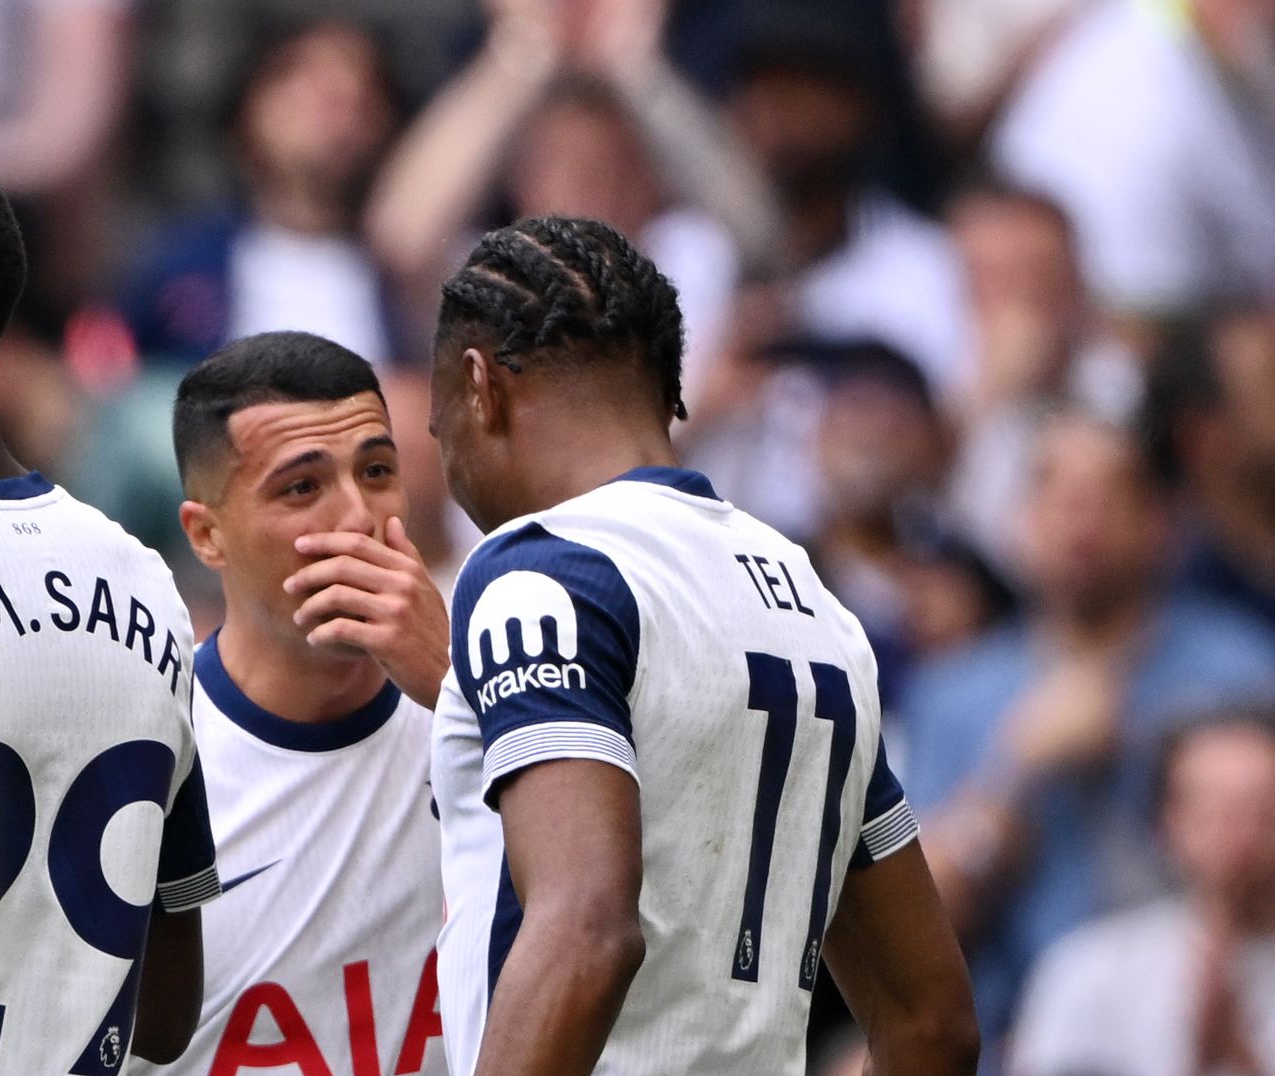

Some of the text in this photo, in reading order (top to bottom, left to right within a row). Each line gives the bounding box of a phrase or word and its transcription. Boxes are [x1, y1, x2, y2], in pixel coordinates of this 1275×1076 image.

[11, 520, 43, 536] 868
[733, 553, 815, 620] TEL
[476, 662, 587, 715] kraken
[731, 650, 857, 992] 11
